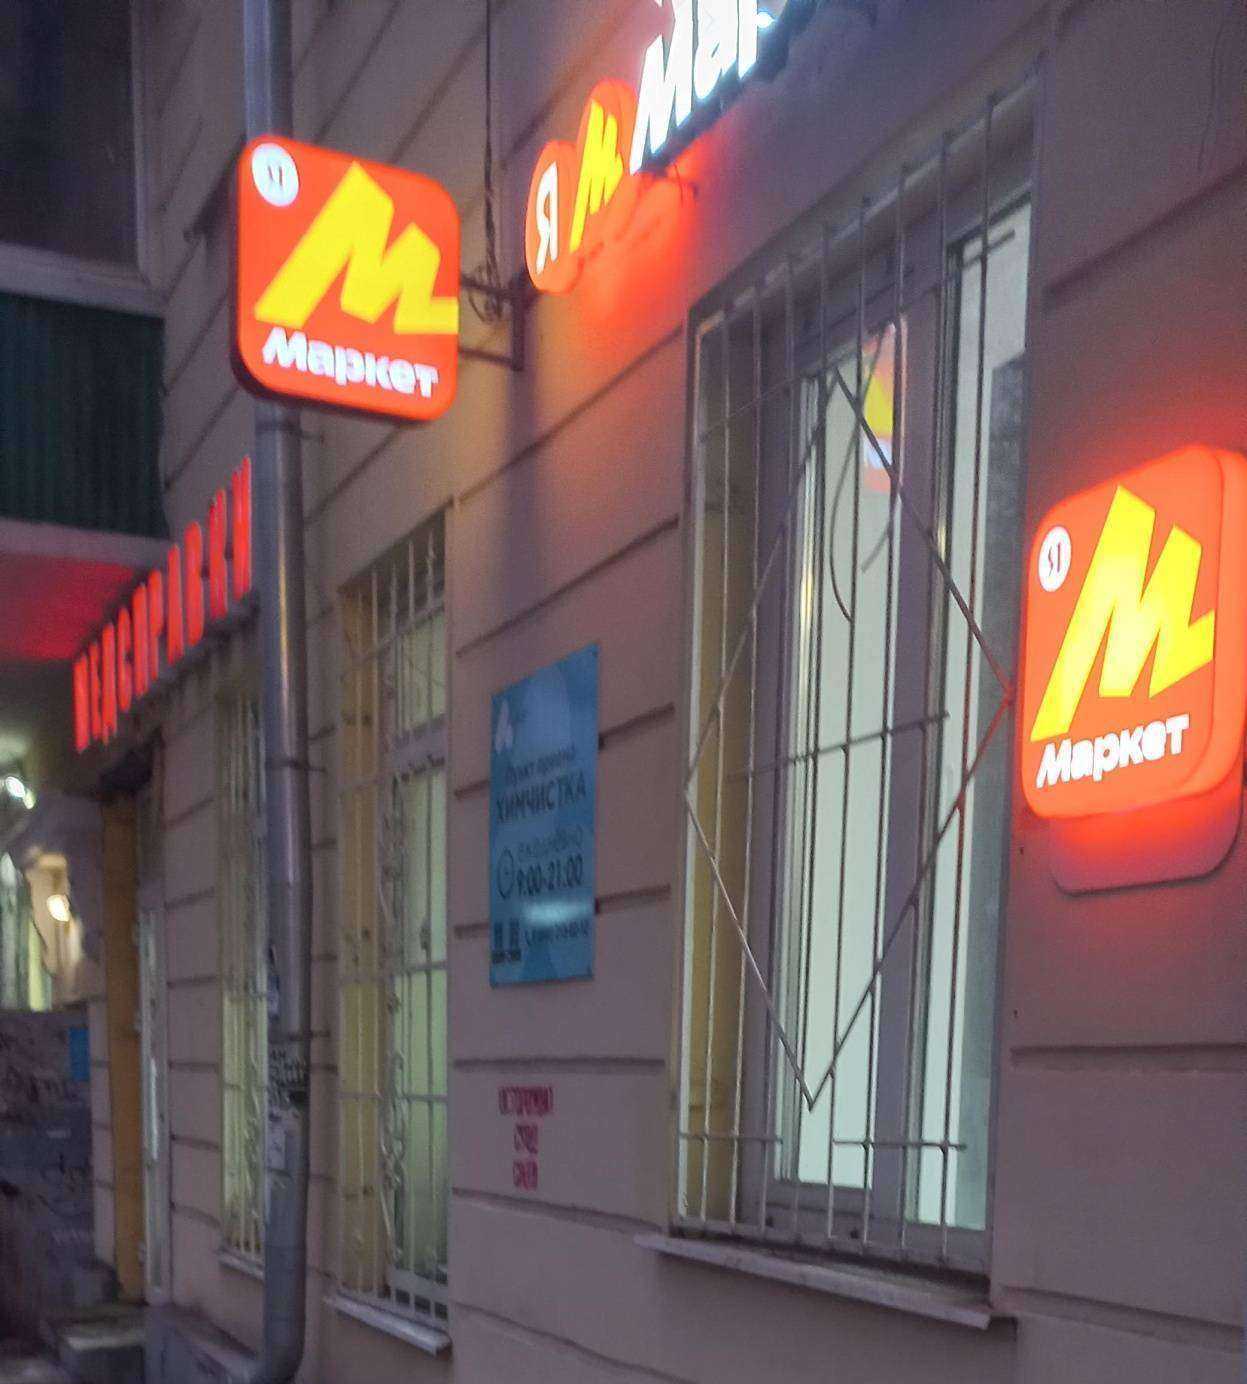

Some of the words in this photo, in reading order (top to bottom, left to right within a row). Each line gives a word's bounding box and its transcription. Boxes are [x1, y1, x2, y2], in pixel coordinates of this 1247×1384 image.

[262, 326, 439, 398] Маркет
[1036, 713, 1190, 790] Маркет
[496, 769, 587, 824] ХИМЧИСТКА
